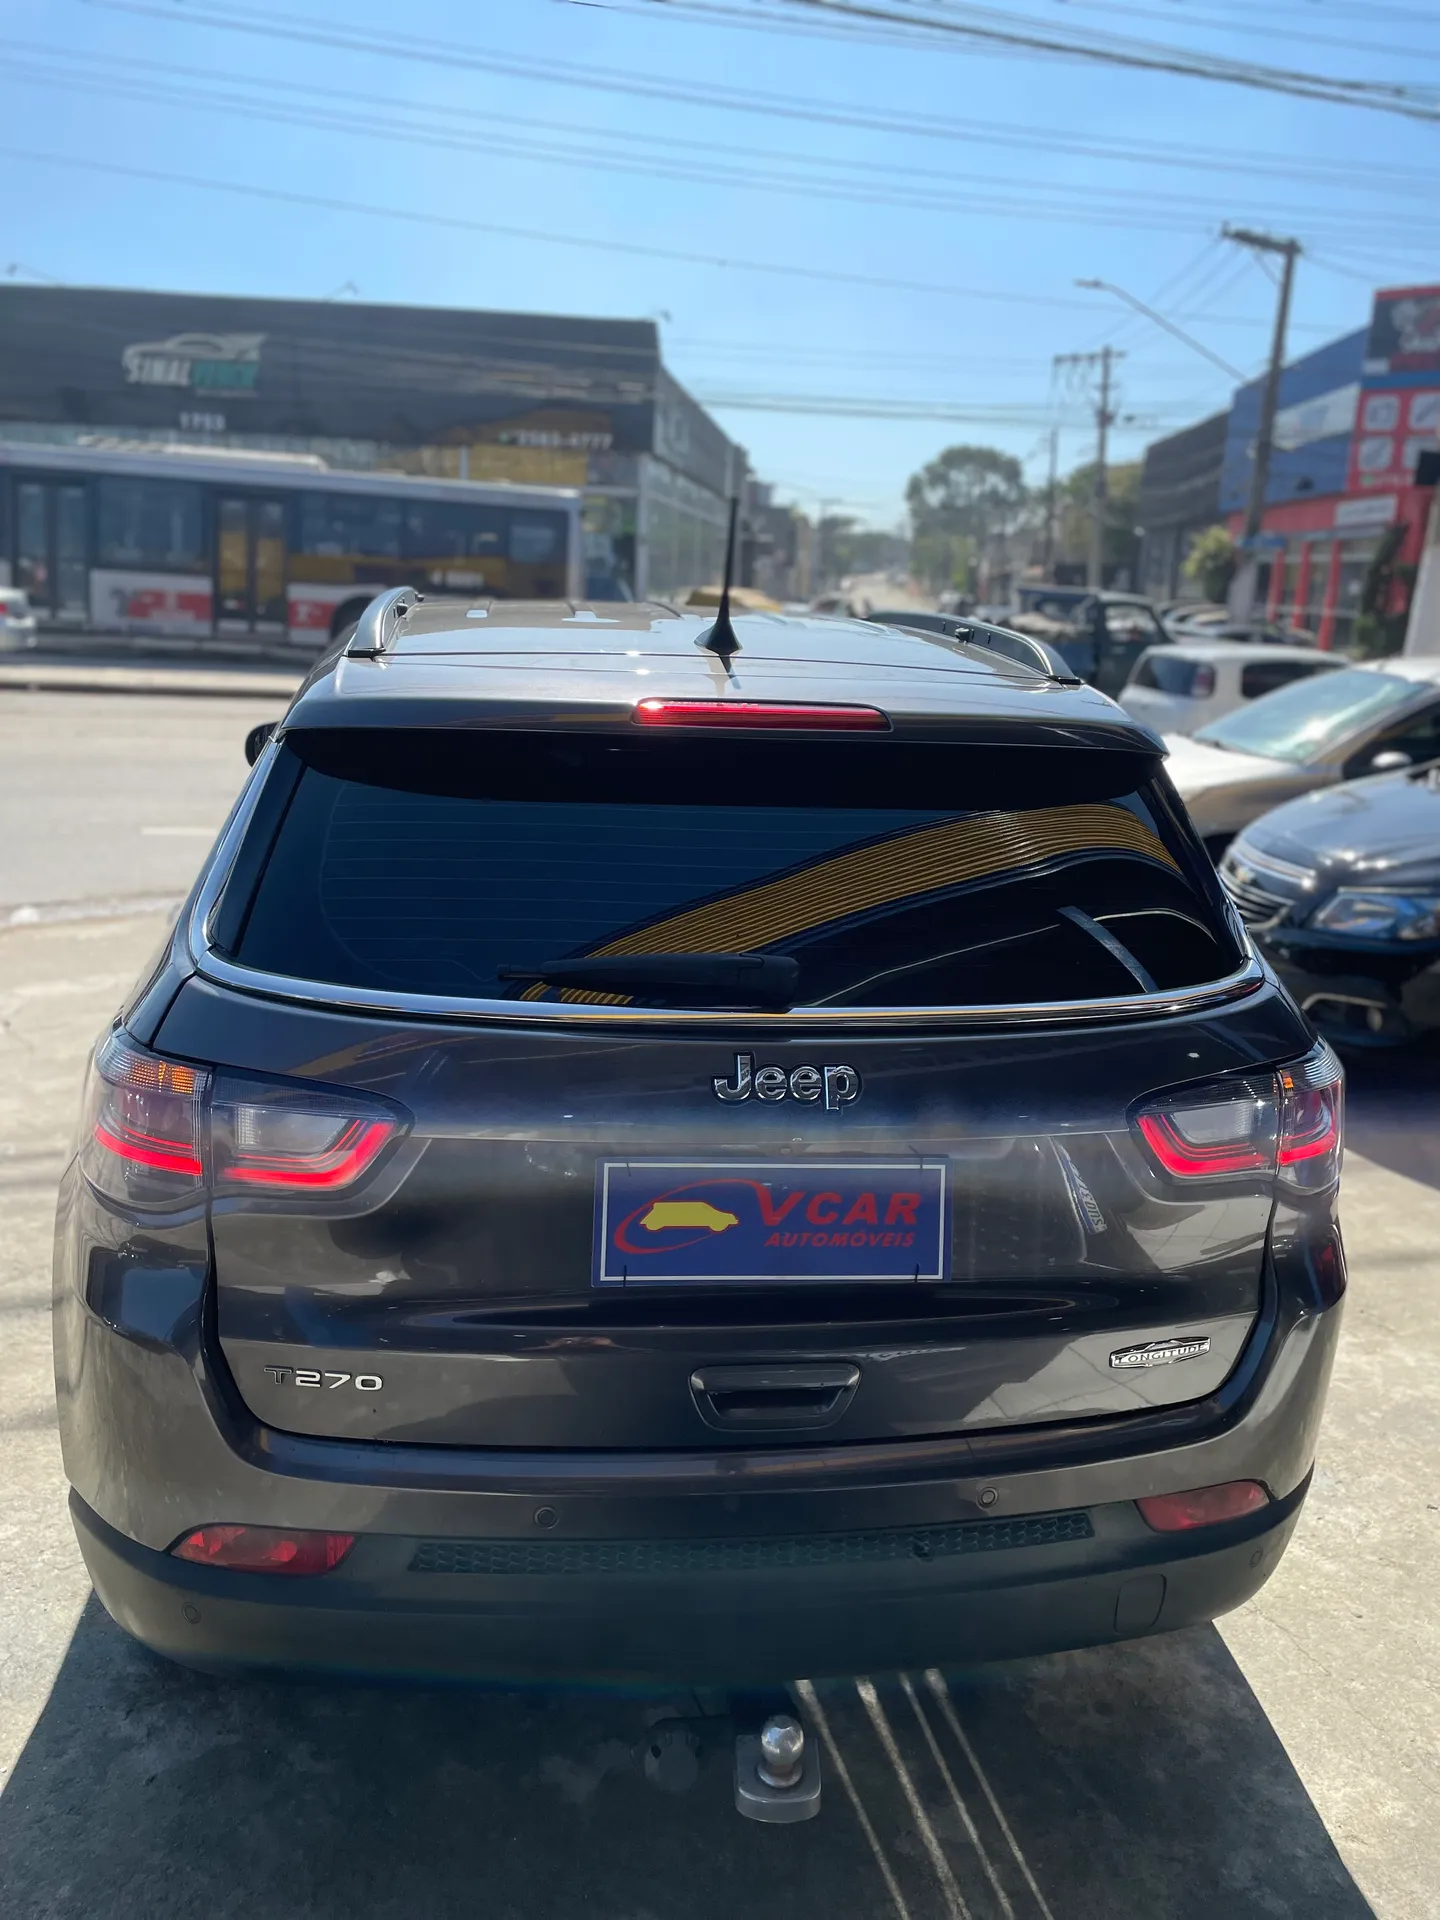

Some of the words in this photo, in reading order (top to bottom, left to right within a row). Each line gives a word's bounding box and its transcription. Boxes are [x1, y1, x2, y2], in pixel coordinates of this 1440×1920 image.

[713, 1053, 861, 1111] Jeep
[757, 1190, 922, 1227] VCAR
[1113, 1340, 1209, 1364] LONGITUDE
[264, 1367, 384, 1391] T270
